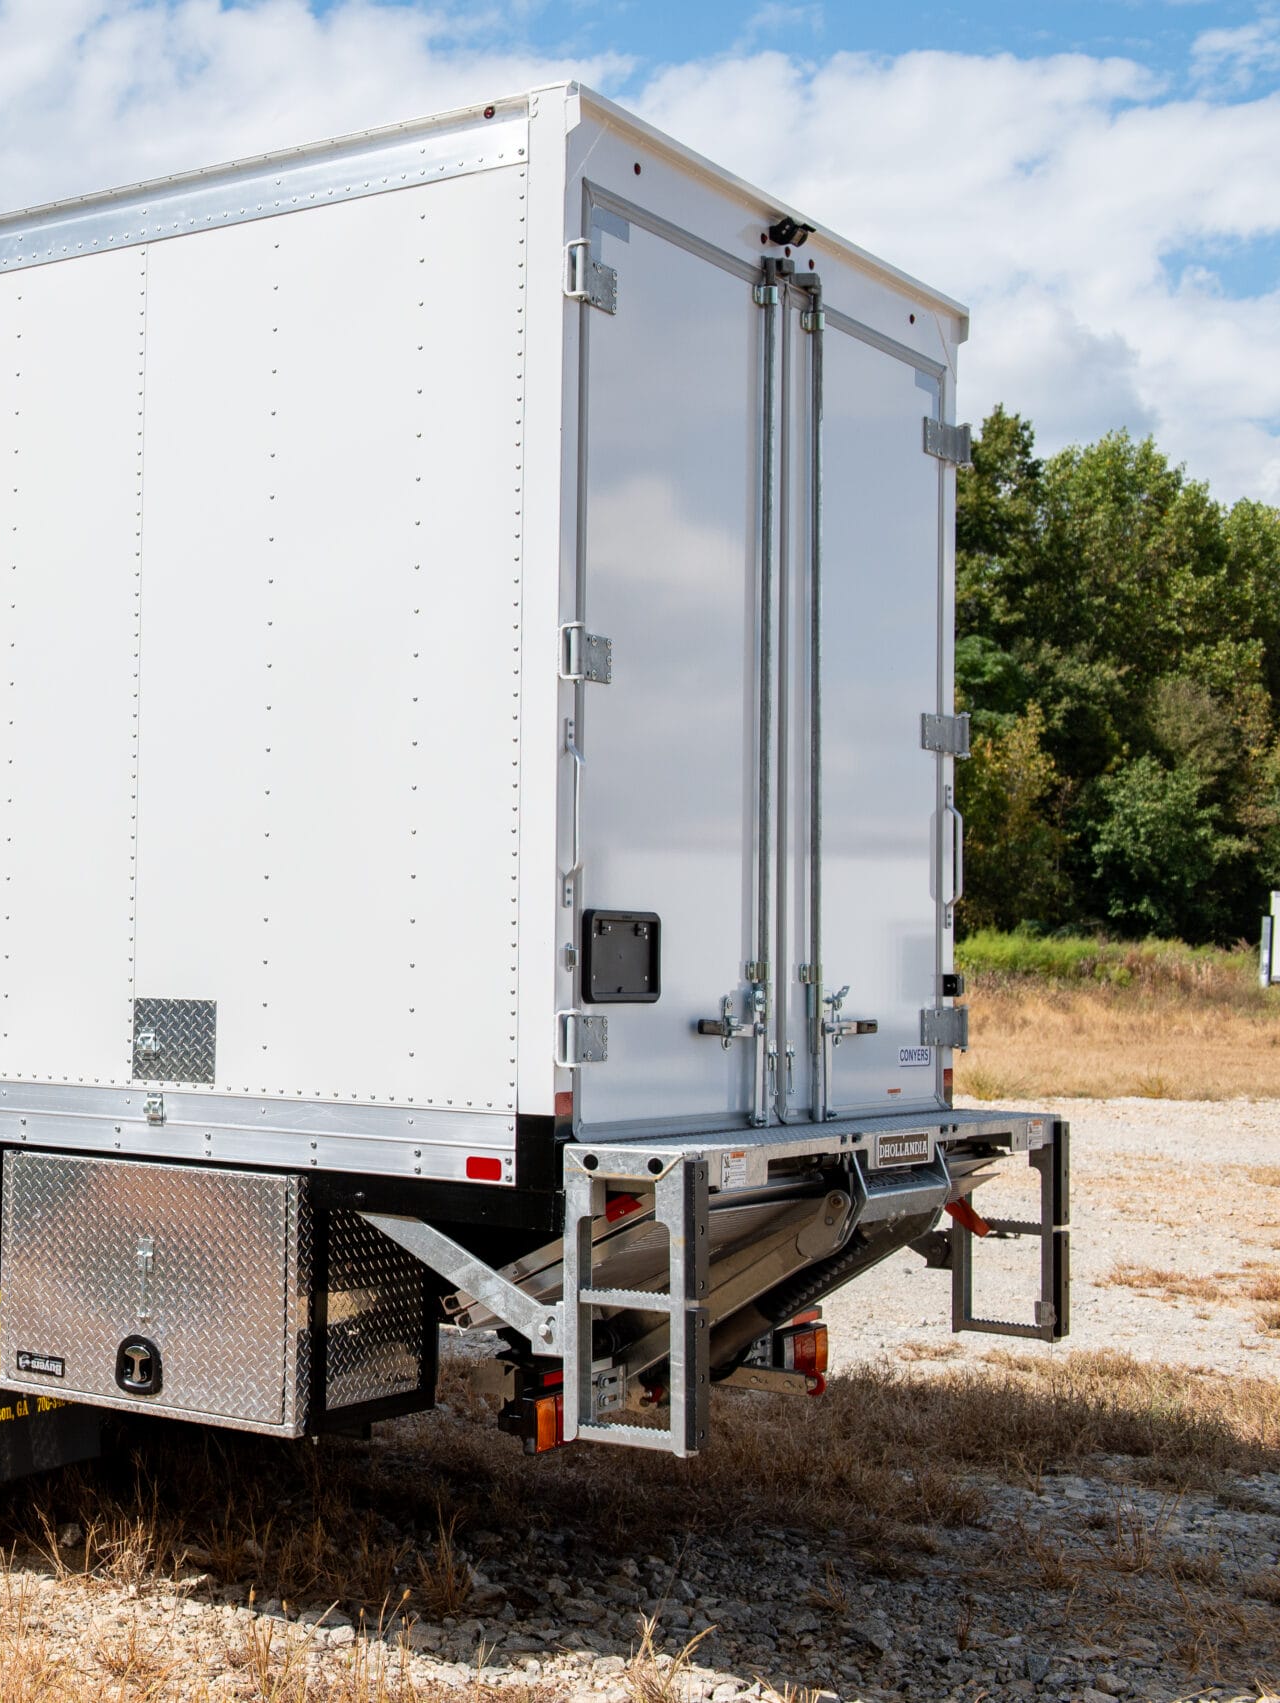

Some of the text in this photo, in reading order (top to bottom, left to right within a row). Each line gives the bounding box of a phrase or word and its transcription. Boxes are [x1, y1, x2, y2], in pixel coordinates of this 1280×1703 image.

[899, 1049, 929, 1061] CONYERS
[880, 1140, 928, 1158] DHOLLANDIA
[31, 1360, 62, 1376] Buyers
[16, 1400, 29, 1417] GA
